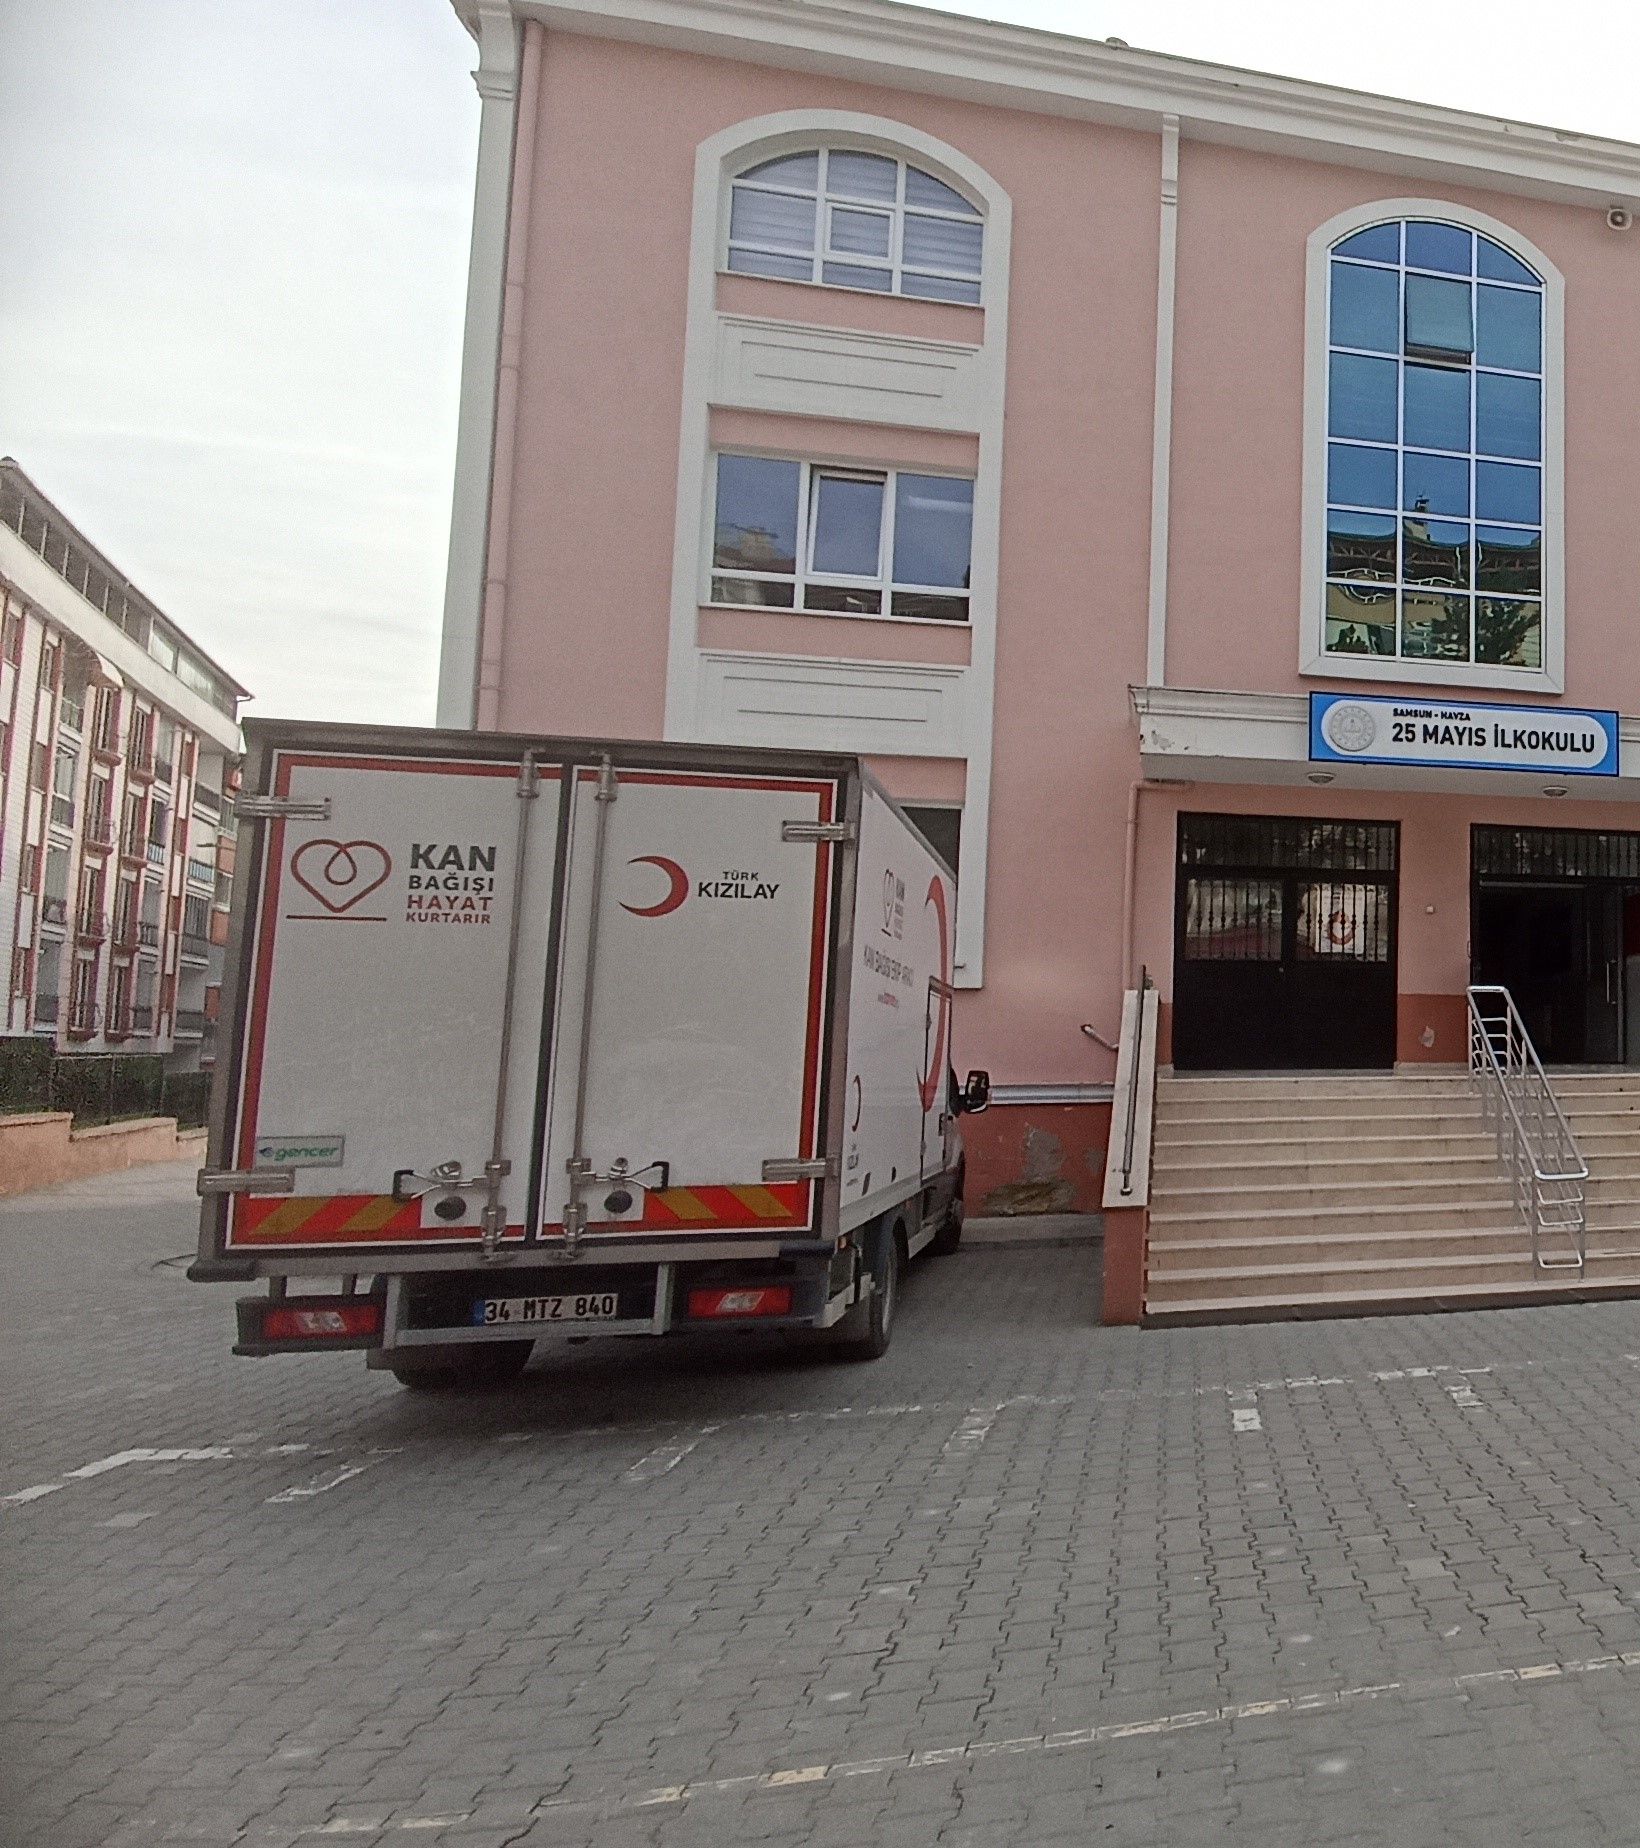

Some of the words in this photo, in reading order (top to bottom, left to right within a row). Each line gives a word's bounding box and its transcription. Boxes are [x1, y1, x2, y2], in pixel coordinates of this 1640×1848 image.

[1393, 707, 1432, 718] SAMSUN
[1441, 710, 1471, 721] HAVZA
[1392, 722, 1416, 742] 25
[1422, 724, 1486, 746] MAYIS
[1494, 723, 1595, 753] İLKOKULU
[410, 843, 497, 872] KAN
[408, 872, 494, 895] BAĞIŞI
[722, 871, 759, 881] TÜRK
[698, 882, 780, 899] KIZILAY
[407, 895, 493, 911] HAYAT
[405, 912, 491, 924] KURTARIR
[485, 1301, 510, 1321] 34
[524, 1299, 563, 1319] MTZ
[575, 1296, 614, 1316] 840
